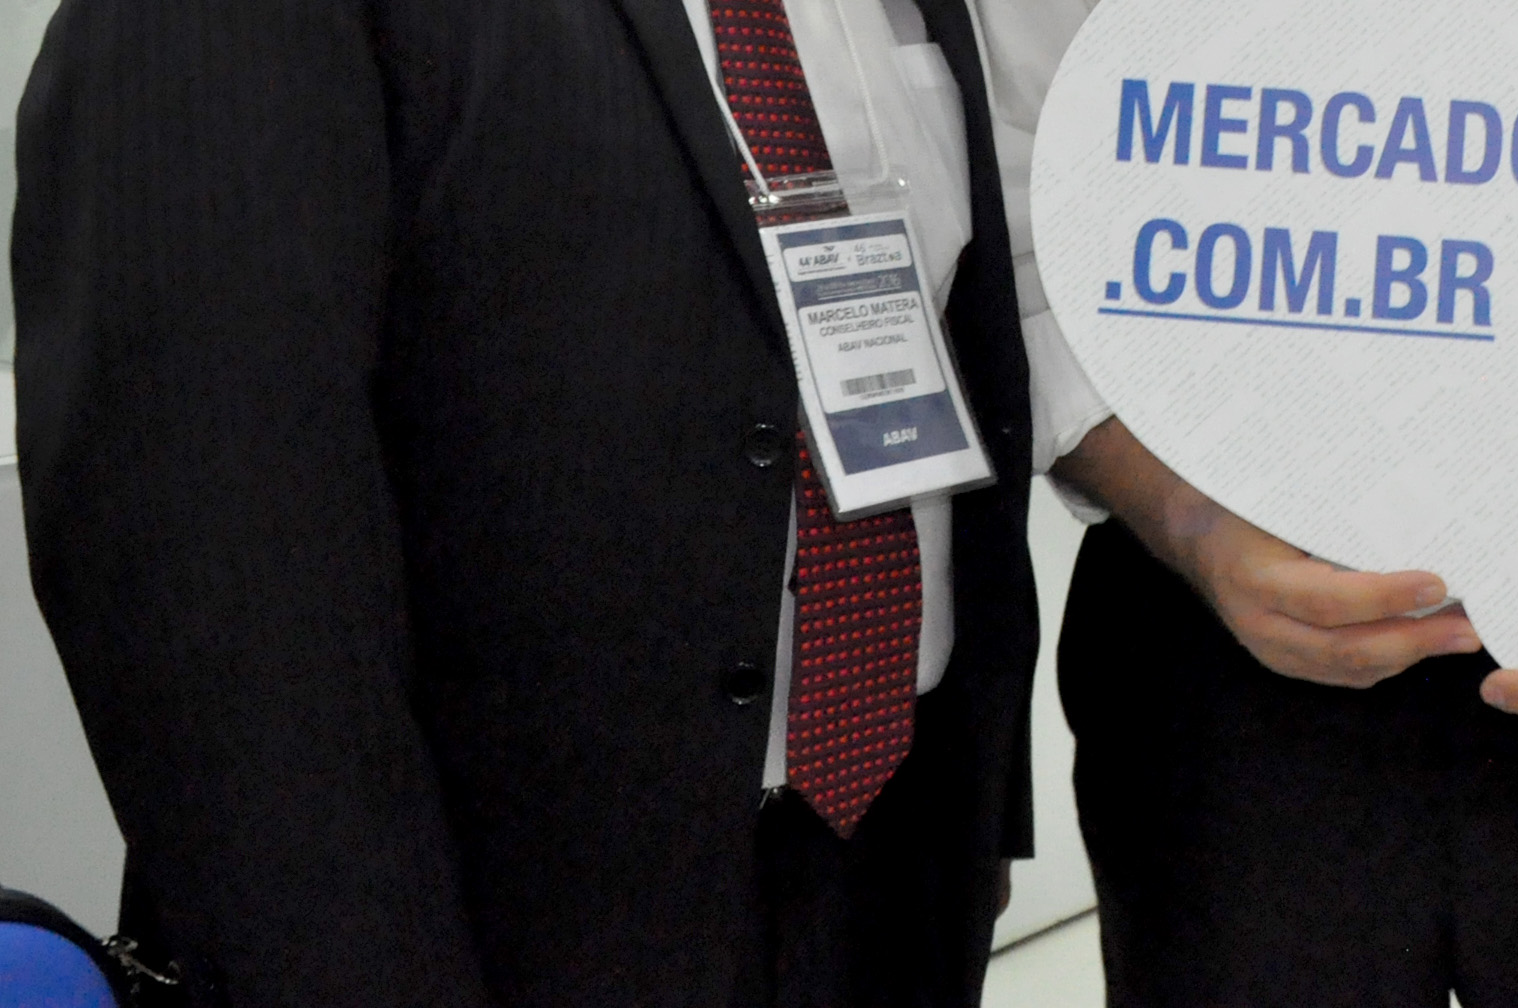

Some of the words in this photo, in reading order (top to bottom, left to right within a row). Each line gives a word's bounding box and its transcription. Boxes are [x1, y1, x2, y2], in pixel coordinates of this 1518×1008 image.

[1105, 218, 1494, 326] .COM.BR
[807, 304, 869, 326] MARCELO
[870, 297, 919, 316] MATERA
[838, 340, 863, 352] ABAV
[882, 426, 918, 448] ABAV
